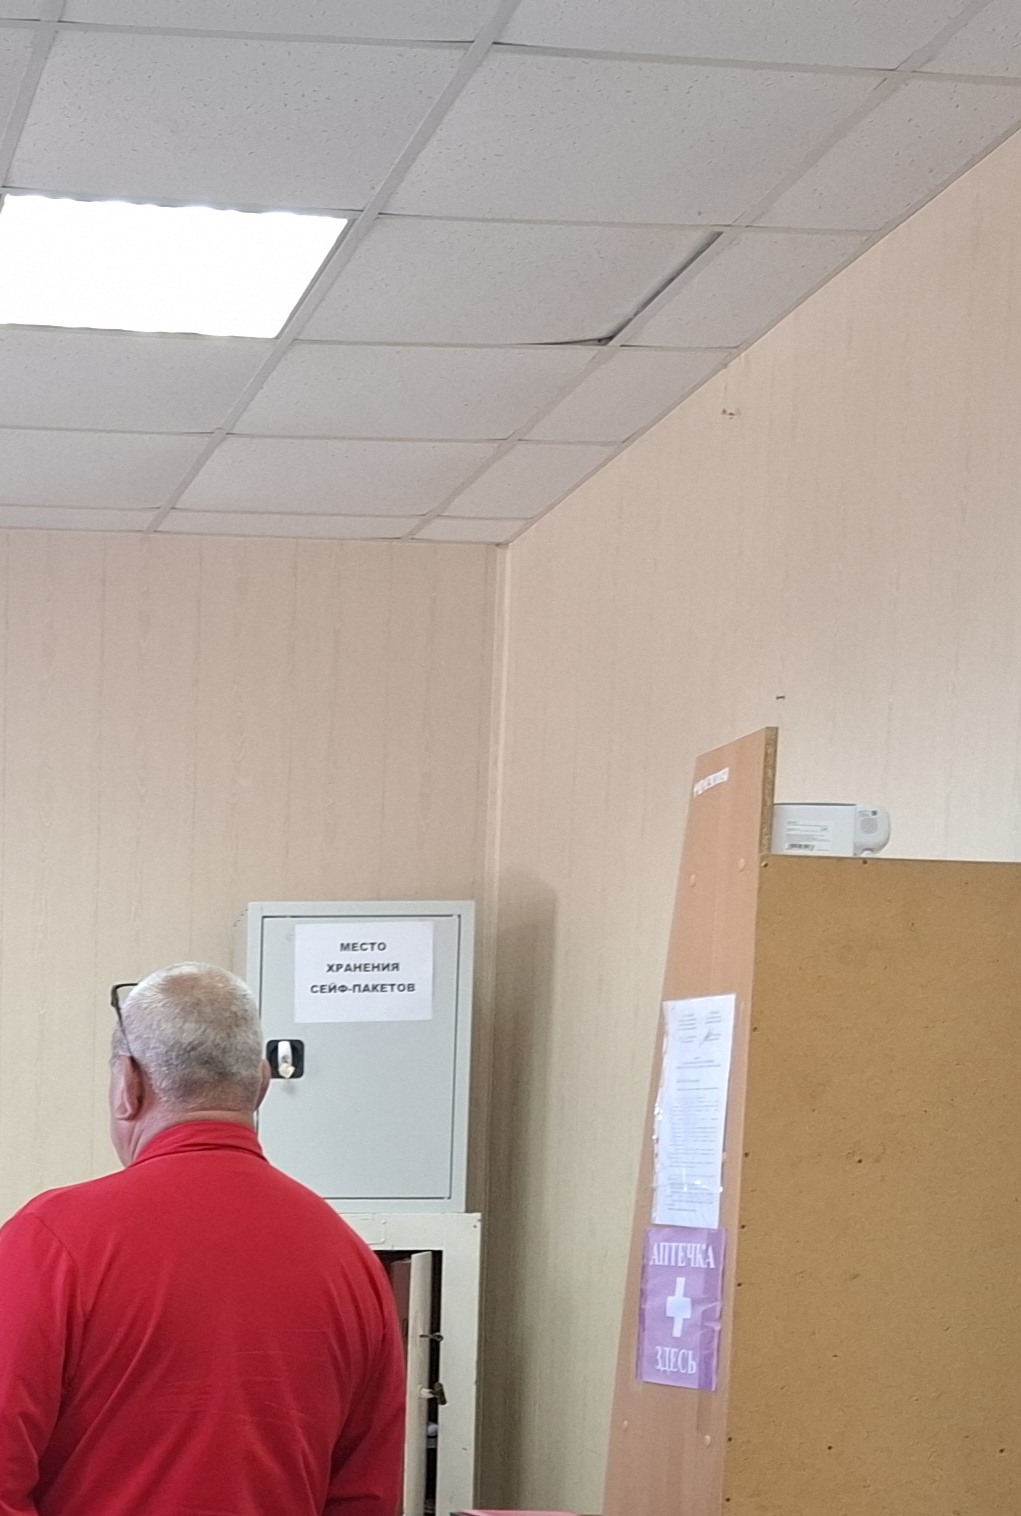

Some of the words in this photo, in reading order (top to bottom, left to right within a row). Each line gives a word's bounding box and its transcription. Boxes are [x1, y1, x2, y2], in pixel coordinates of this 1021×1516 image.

[339, 941, 387, 952] МЕСТО
[325, 962, 400, 973] ХРАНЕНИЯ
[310, 982, 416, 994] СЕЙФ-ПАКЕТОВ
[649, 1242, 716, 1269] АПТЕЧКА
[654, 1345, 697, 1375] ЗДЕСЬ
